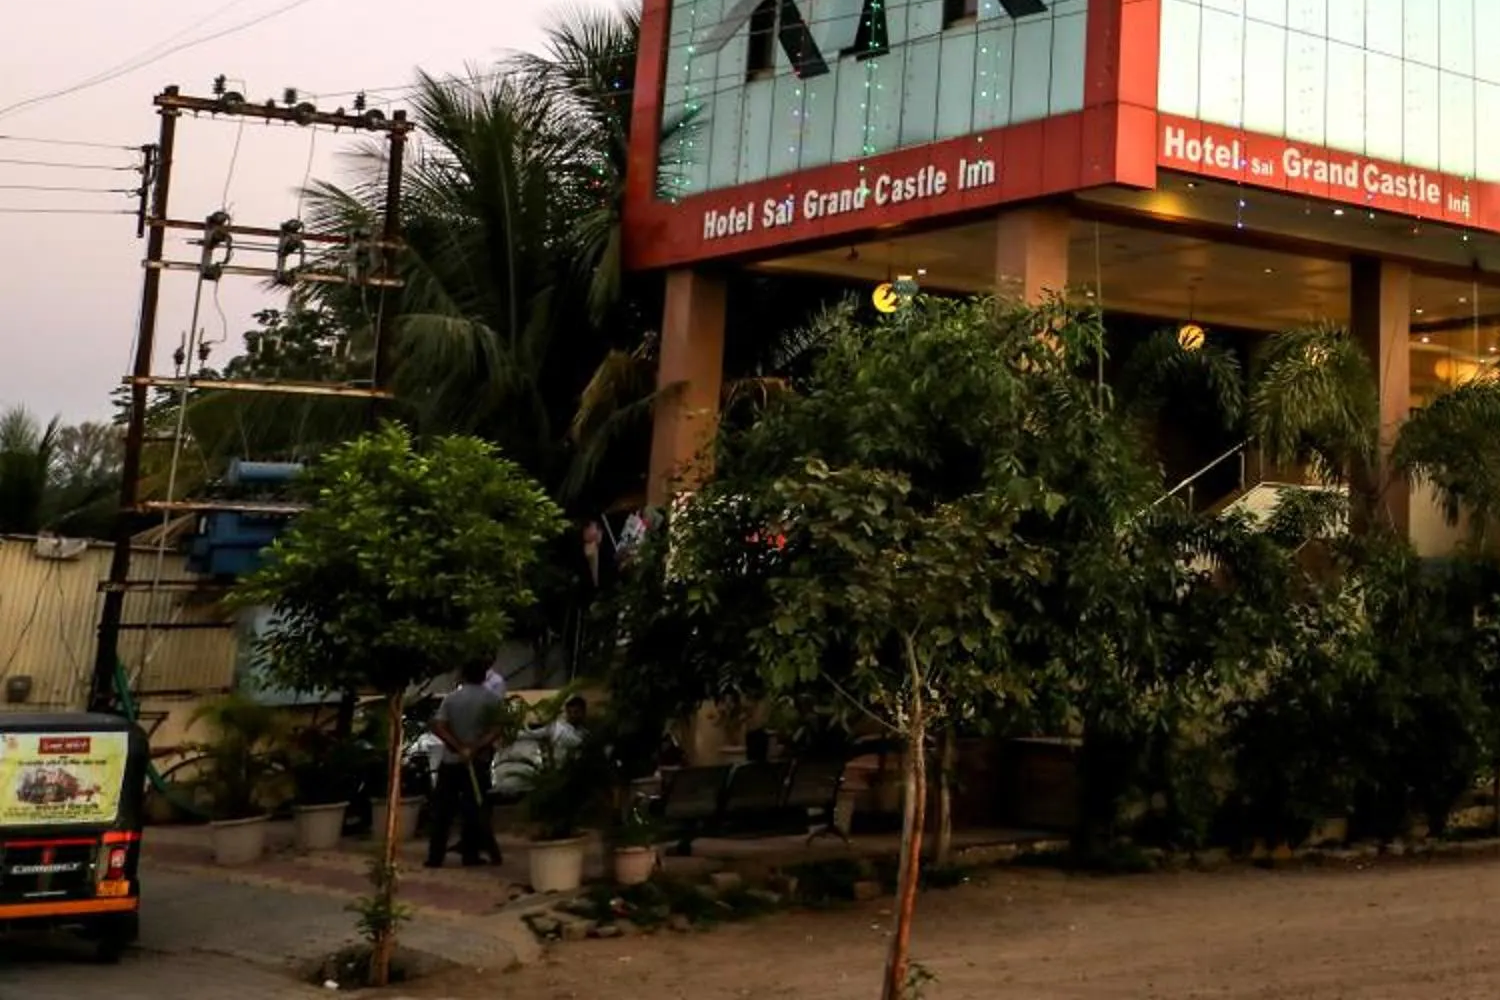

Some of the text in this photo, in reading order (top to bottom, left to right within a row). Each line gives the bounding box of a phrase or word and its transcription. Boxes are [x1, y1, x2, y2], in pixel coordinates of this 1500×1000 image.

[703, 157, 996, 239] Hotel Sai Grand Castle Inn
[1163, 125, 1470, 214] Hotel Sai Grand Castle Inn
